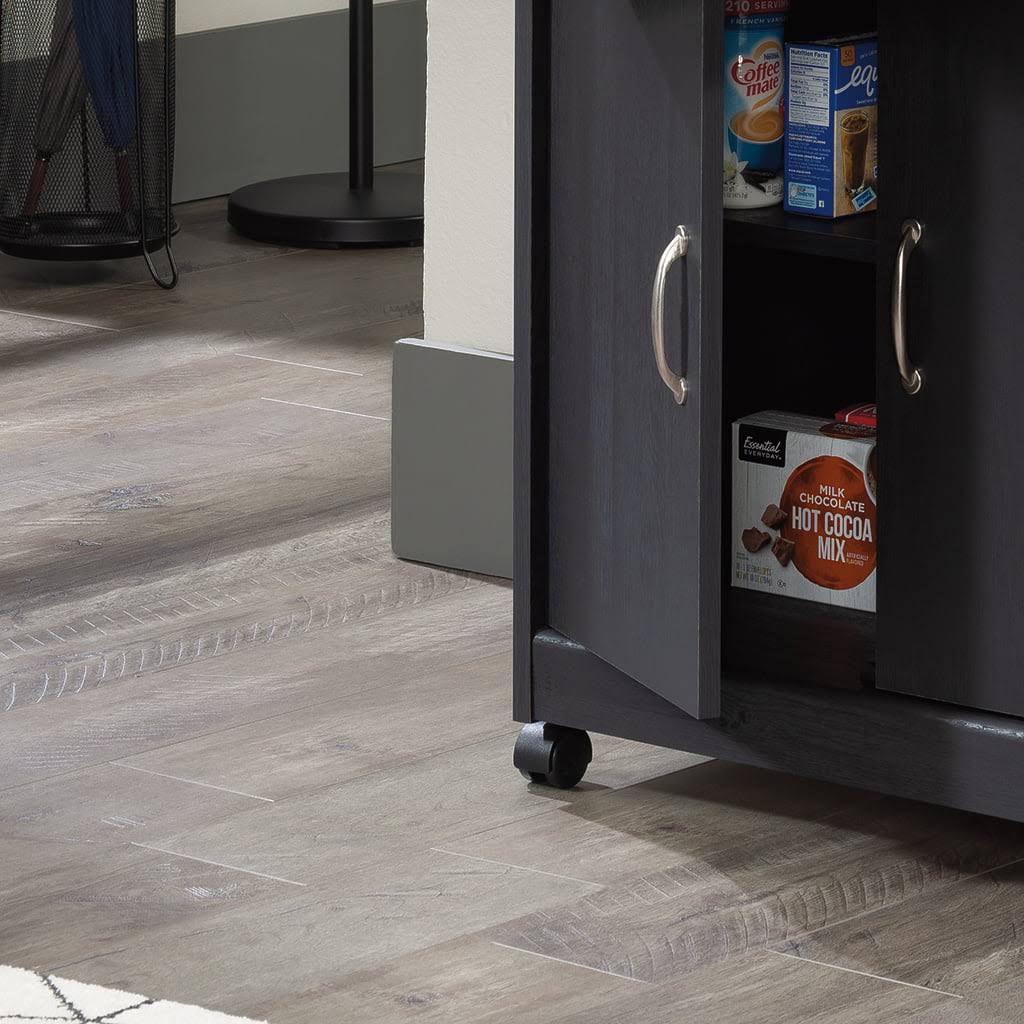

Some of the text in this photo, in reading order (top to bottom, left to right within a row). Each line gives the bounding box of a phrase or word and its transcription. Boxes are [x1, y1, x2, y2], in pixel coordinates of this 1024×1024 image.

[724, 0, 751, 13] 210
[790, 48, 828, 59] Nutrition Facts
[731, 59, 780, 85] Coffee
[746, 75, 779, 97] mate
[743, 436, 782, 453] Essential
[819, 484, 845, 498] MILK
[800, 492, 865, 513] CHOCOLATE
[792, 506, 873, 542] HOT COCOA
[818, 535, 846, 563] MIX
